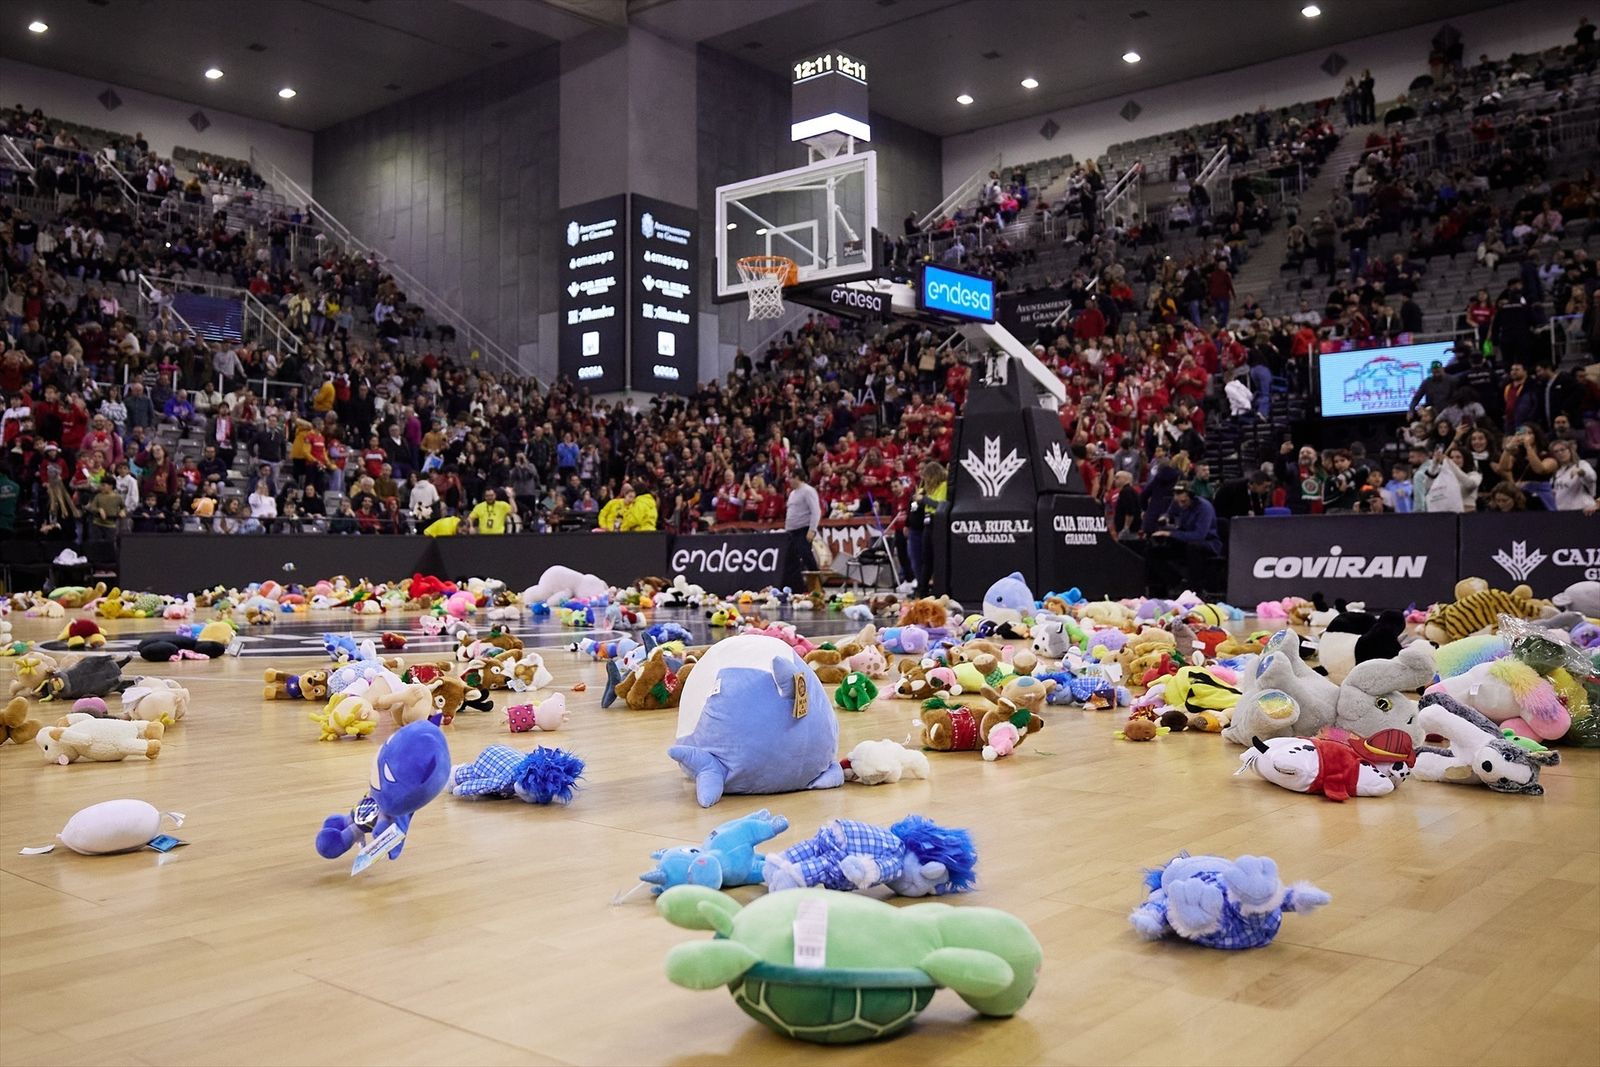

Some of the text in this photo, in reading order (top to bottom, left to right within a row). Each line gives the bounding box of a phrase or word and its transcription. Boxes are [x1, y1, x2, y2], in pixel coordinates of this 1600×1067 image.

[794, 54, 832, 79] 12:11
[836, 54, 866, 80] 12:11
[831, 288, 882, 311] endesa
[928, 280, 991, 310] endesa
[951, 519, 1033, 534] CAJA RURAL
[1053, 515, 1108, 532] CAJA RURAL
[967, 534, 1016, 543] GRANADA
[1065, 533, 1097, 545] GRANADA
[672, 542, 779, 573] endesa
